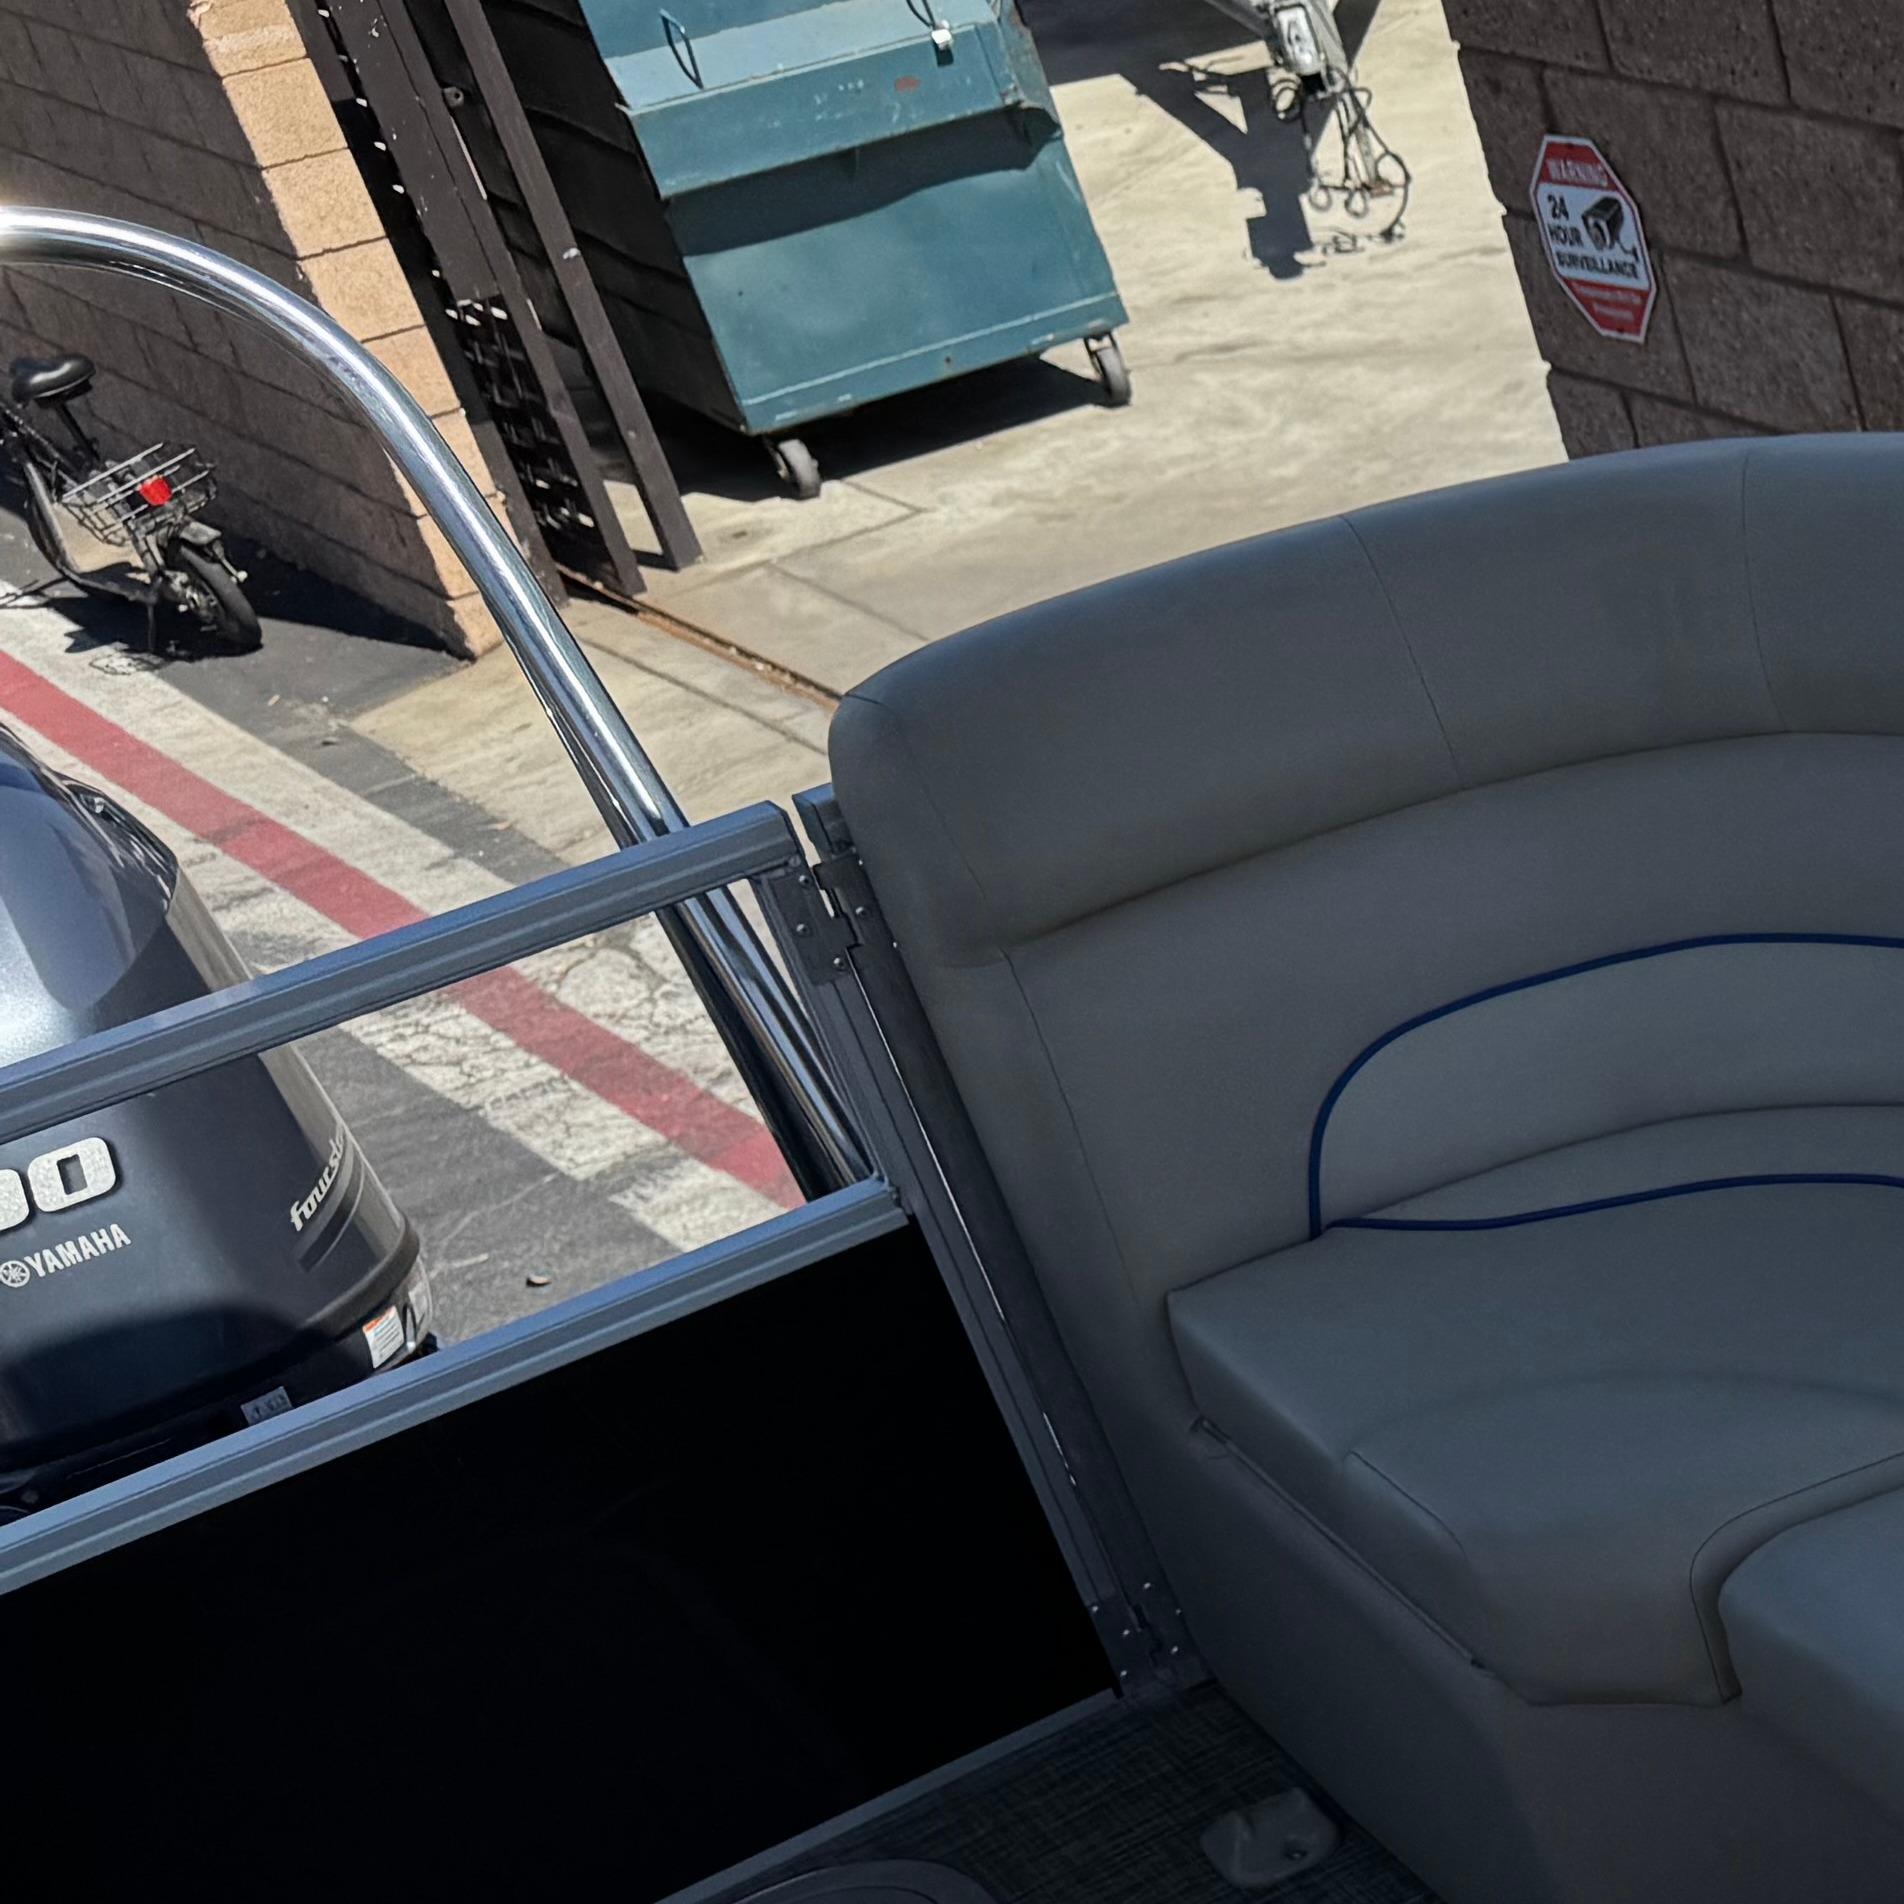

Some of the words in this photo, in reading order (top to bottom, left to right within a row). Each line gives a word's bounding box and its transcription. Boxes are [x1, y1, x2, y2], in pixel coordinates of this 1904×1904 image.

[1547, 194, 1569, 220] 24
[1547, 224, 1583, 247] HOUR
[1556, 251, 1638, 279] SURVEILLANCE
[24, 1223, 132, 1277] YAMAHA
